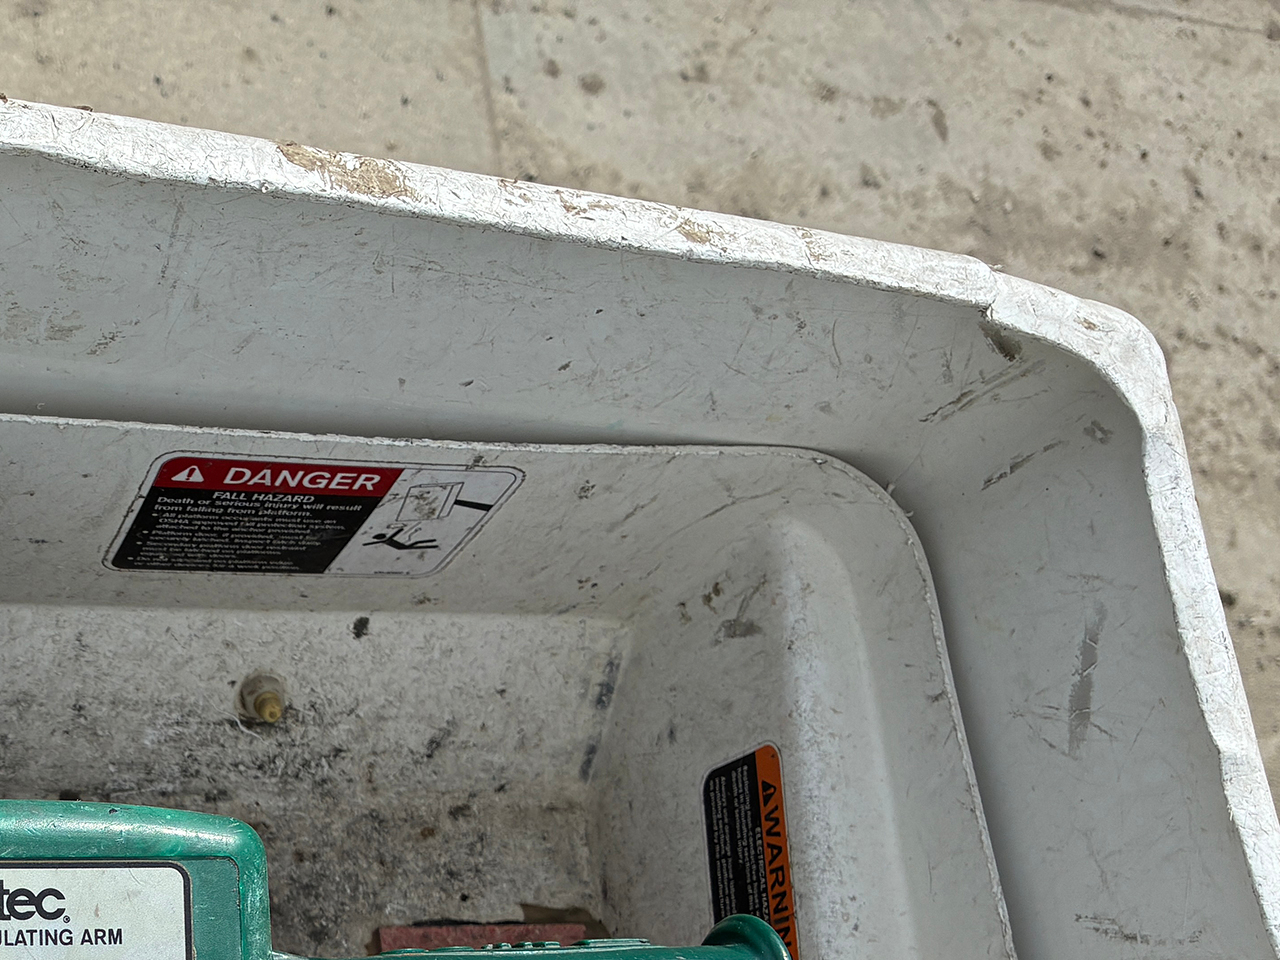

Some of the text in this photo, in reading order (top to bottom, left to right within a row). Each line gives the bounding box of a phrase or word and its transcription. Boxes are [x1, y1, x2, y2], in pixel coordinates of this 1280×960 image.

[223, 466, 383, 491] DANGER
[212, 491, 315, 503] FALL HAZARD
[765, 805, 795, 952] WARNIN
[81, 928, 123, 945] ARM
